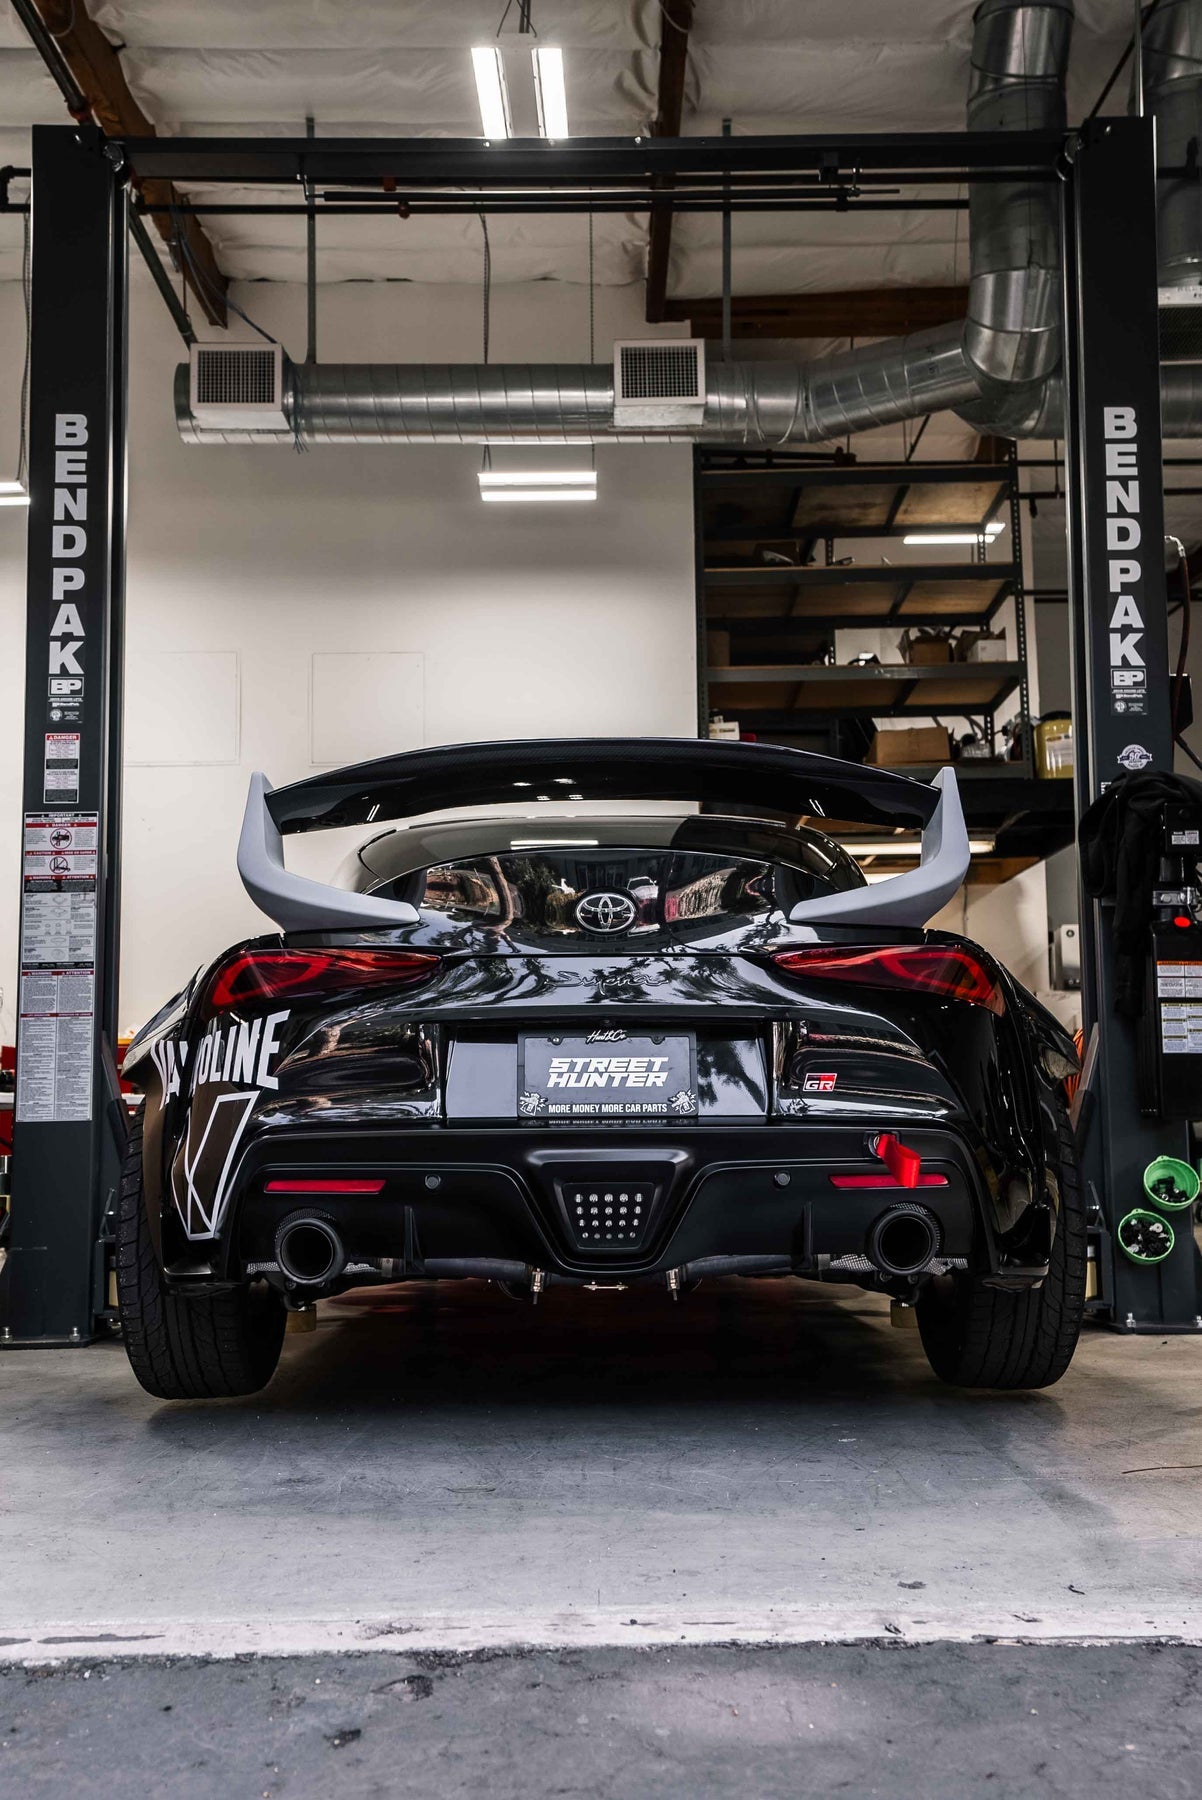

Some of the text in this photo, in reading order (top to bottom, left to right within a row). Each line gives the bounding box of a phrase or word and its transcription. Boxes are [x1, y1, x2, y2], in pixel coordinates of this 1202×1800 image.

[48, 413, 89, 674] BENDPAK
[1103, 406, 1146, 666] BENDPAK
[1113, 671, 1144, 686] BP
[51, 679, 82, 695] BP
[548, 1057, 669, 1072] STREET
[546, 1072, 669, 1088] HUNTER
[805, 1080, 834, 1090] GR
[548, 1104, 668, 1113] MORE MONEY MORE CAR PARTS
